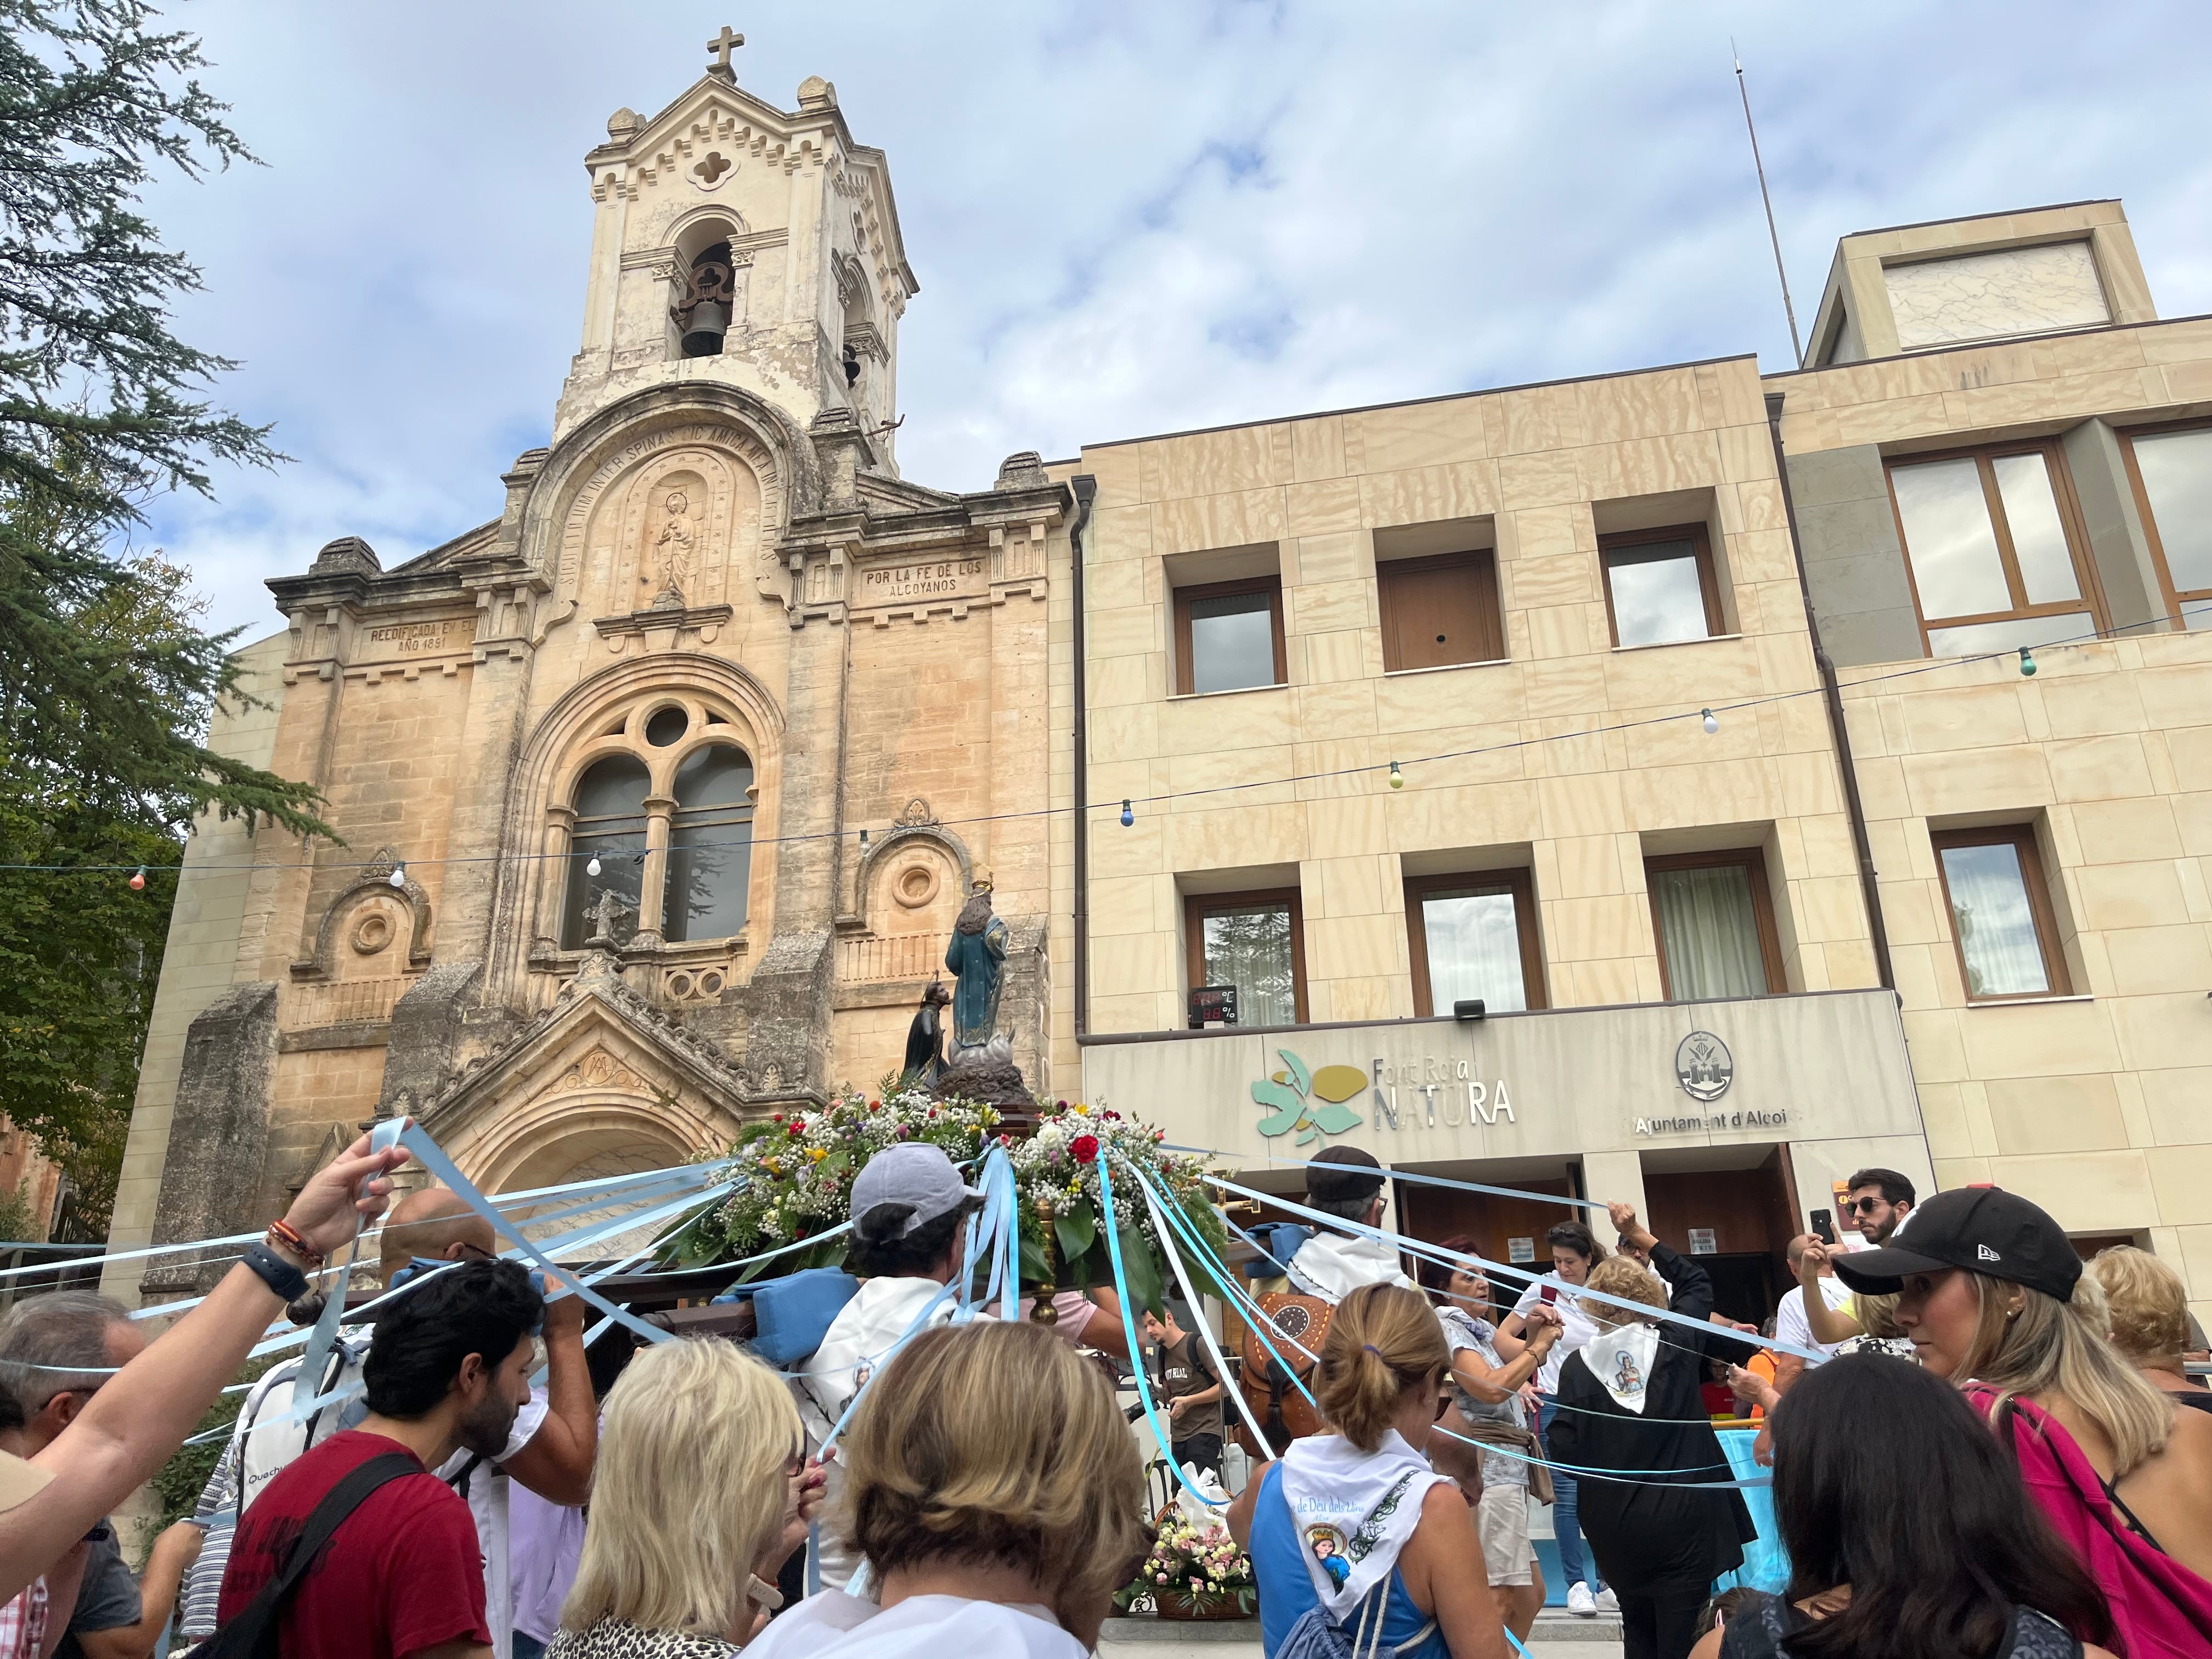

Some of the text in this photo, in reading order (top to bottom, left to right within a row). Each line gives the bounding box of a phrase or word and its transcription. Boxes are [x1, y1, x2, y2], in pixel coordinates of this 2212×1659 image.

[587, 457, 625, 491] INTER
[626, 430, 675, 460] SPINAS
[708, 427, 748, 452] AMICA
[747, 444, 772, 472] MEA
[867, 561, 981, 585] POR LA FE DE LOS
[889, 579, 956, 597] ALCOYANOS
[371, 620, 475, 642] REEDIFICADA EN EL
[398, 637, 445, 652] AÑO 1891
[1373, 1054, 1469, 1085] Font Roja
[1374, 1080, 1515, 1130] NATURA
[1635, 1114, 1726, 1136] Ajuntament
[249, 1465, 286, 1484] Quechu
[1297, 1497, 1307, 1513] de
[1329, 1495, 1345, 1513] dels
